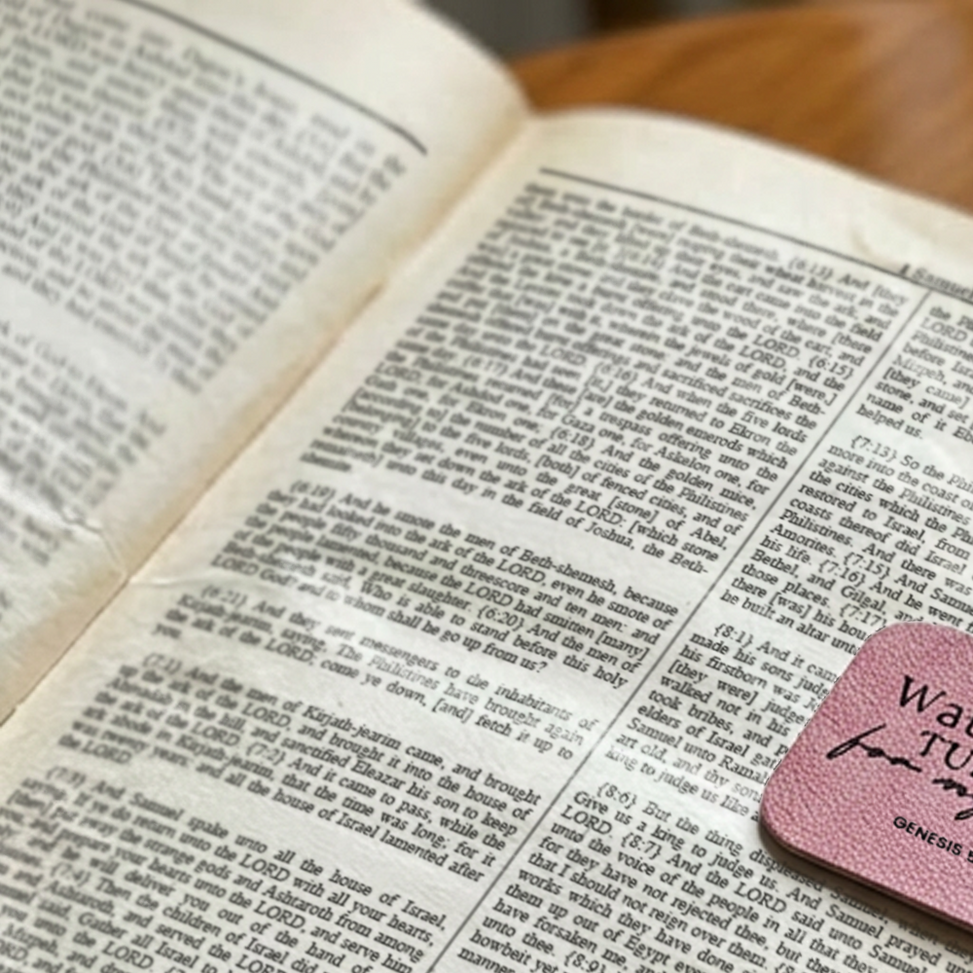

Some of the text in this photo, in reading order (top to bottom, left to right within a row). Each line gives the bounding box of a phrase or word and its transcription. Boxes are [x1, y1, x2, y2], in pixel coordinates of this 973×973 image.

[902, 342, 946, 366] before
[900, 454, 921, 470] So
[922, 464, 945, 481] the
[894, 573, 928, 594] And
[387, 610, 423, 629] shall
[421, 619, 441, 636] he
[439, 629, 461, 643] go
[462, 636, 482, 652] up
[482, 642, 519, 664] from
[519, 657, 548, 673] us?
[826, 724, 924, 773] for
[224, 772, 485, 882] all the house of Israel lamented after
[893, 815, 963, 857] GENESIS
[528, 852, 558, 873] that
[557, 863, 572, 878] I
[569, 871, 622, 901] should
[621, 894, 648, 914] not
[648, 907, 688, 932] reign
[690, 926, 726, 948] over
